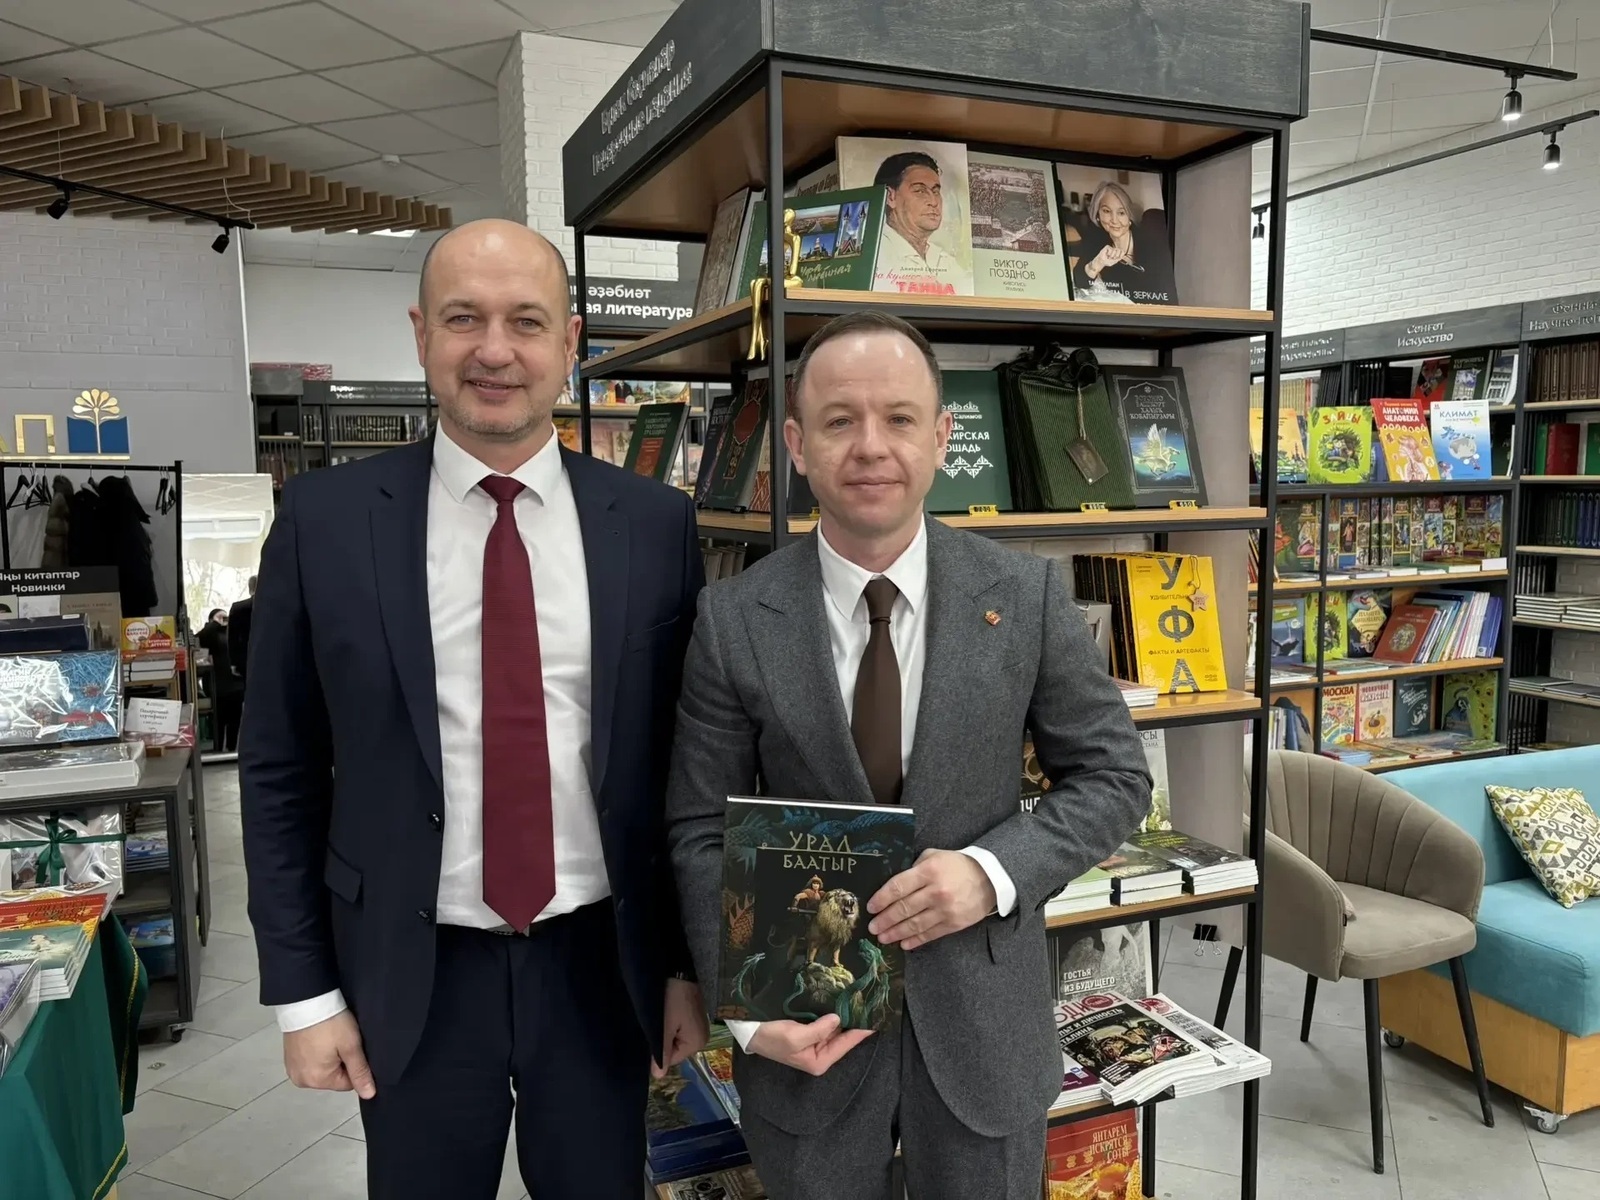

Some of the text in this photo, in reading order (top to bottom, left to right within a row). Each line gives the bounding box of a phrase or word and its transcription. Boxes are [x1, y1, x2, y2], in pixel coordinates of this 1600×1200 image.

[993, 258, 1029, 270] ВИКТОР
[989, 268, 1036, 280] ПОЗДНОВ
[1132, 290, 1169, 301] ЗЕРКАЛЕ
[604, 303, 694, 321] литература
[1397, 333, 1454, 348] Искусство
[1440, 409, 1478, 418] КЛИМАТ
[947, 431, 990, 441] КИРСКАЯ
[945, 443, 982, 453] ОШАДЬ
[24, 571, 81, 581] китаптар
[11, 583, 66, 593] Новинки
[1176, 647, 1210, 655] АРТЕФАКТЫ
[1323, 686, 1354, 697] МОСКВА
[788, 831, 852, 853] УРАЛ
[783, 854, 858, 874] БААТЫР
[1063, 968, 1092, 981] ГОСТЬЯ
[1064, 976, 1116, 993] ИЗ БУДУЩЕГО
[1081, 1008, 1124, 1025] ЛИЧНОСТЬ
[1060, 1026, 1095, 1046] ТАЛИНА
[1092, 1124, 1127, 1143] ЯНТАРЕМ
[1089, 1135, 1128, 1155] ИСКРЯТСЯ
